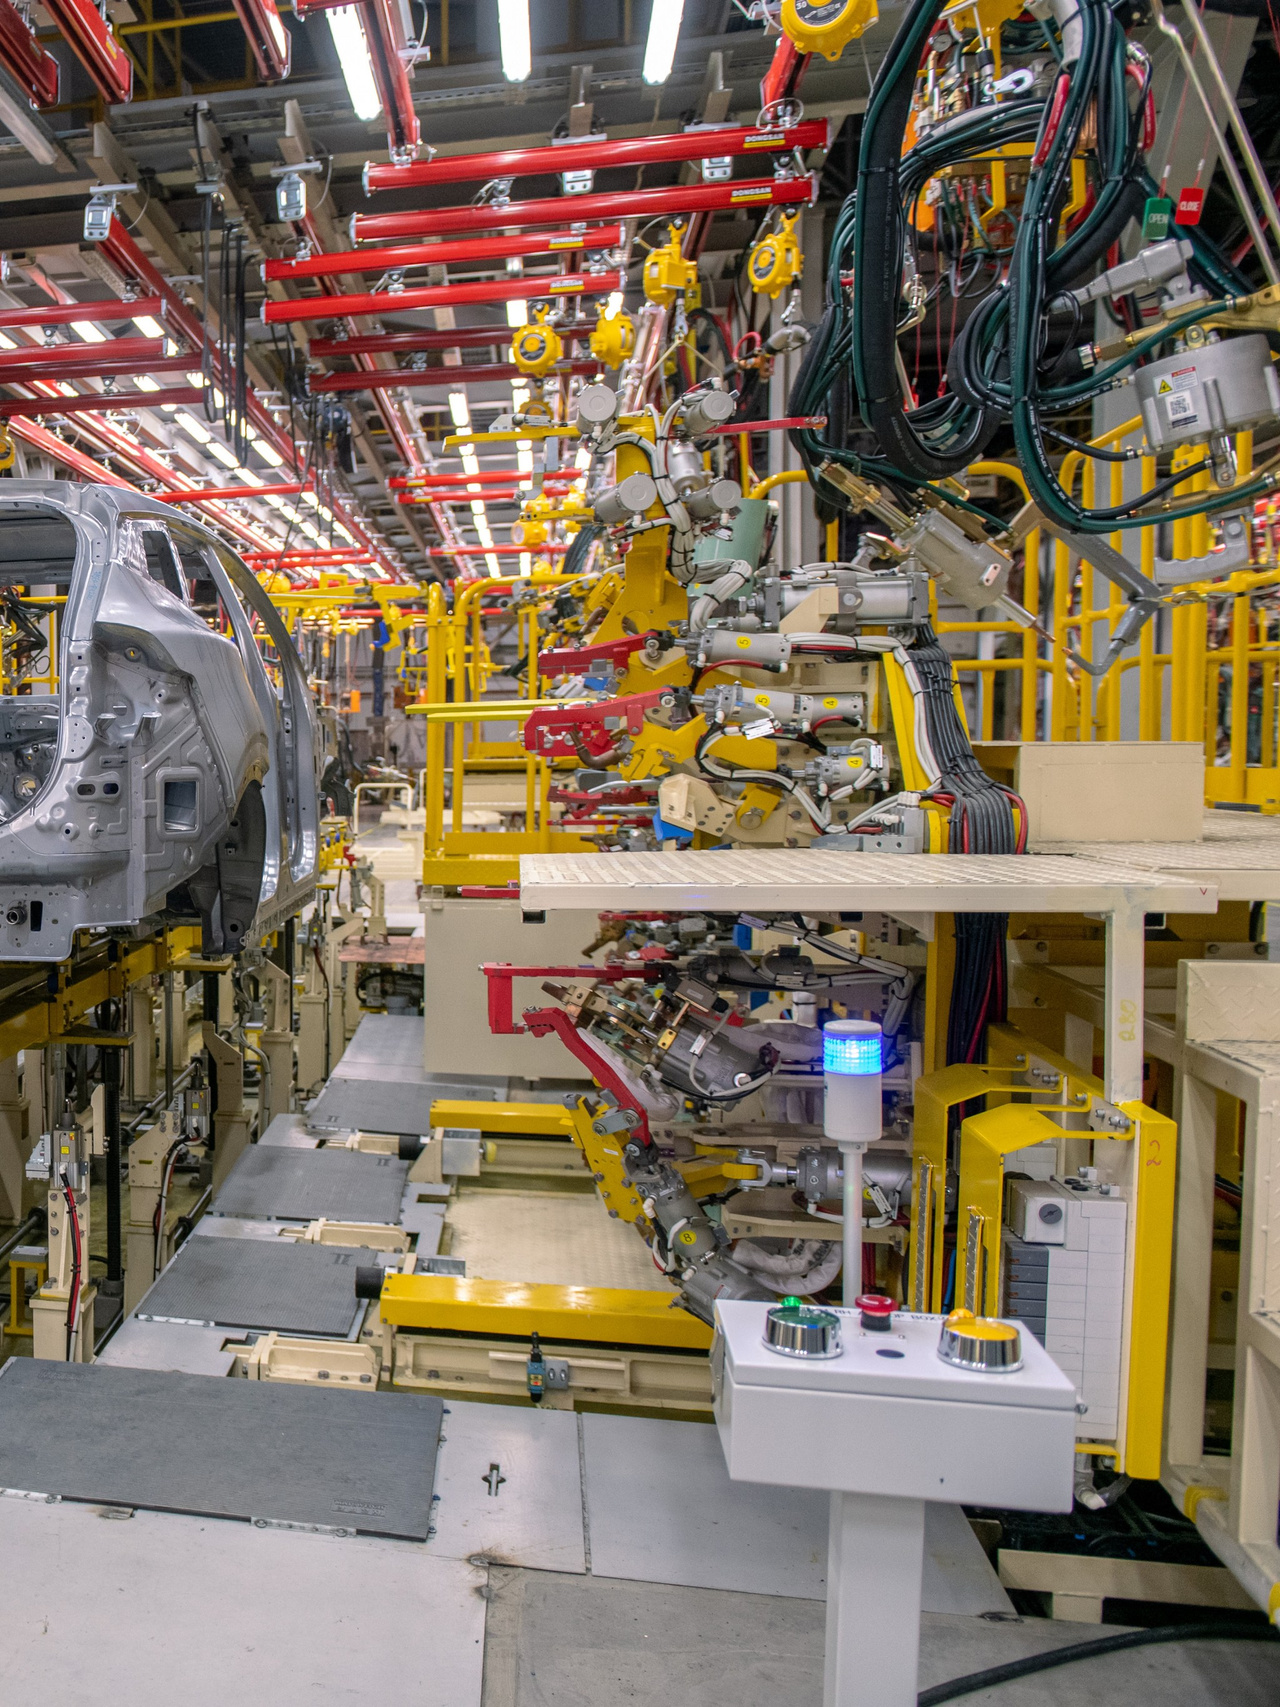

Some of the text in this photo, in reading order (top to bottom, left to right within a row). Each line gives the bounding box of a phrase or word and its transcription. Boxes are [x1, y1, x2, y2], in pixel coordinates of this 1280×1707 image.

[1180, 201, 1200, 211] CLOSE
[1148, 213, 1169, 224] OPEN
[1146, 1139, 1162, 1167] 2
[683, 1233, 693, 1243] 8
